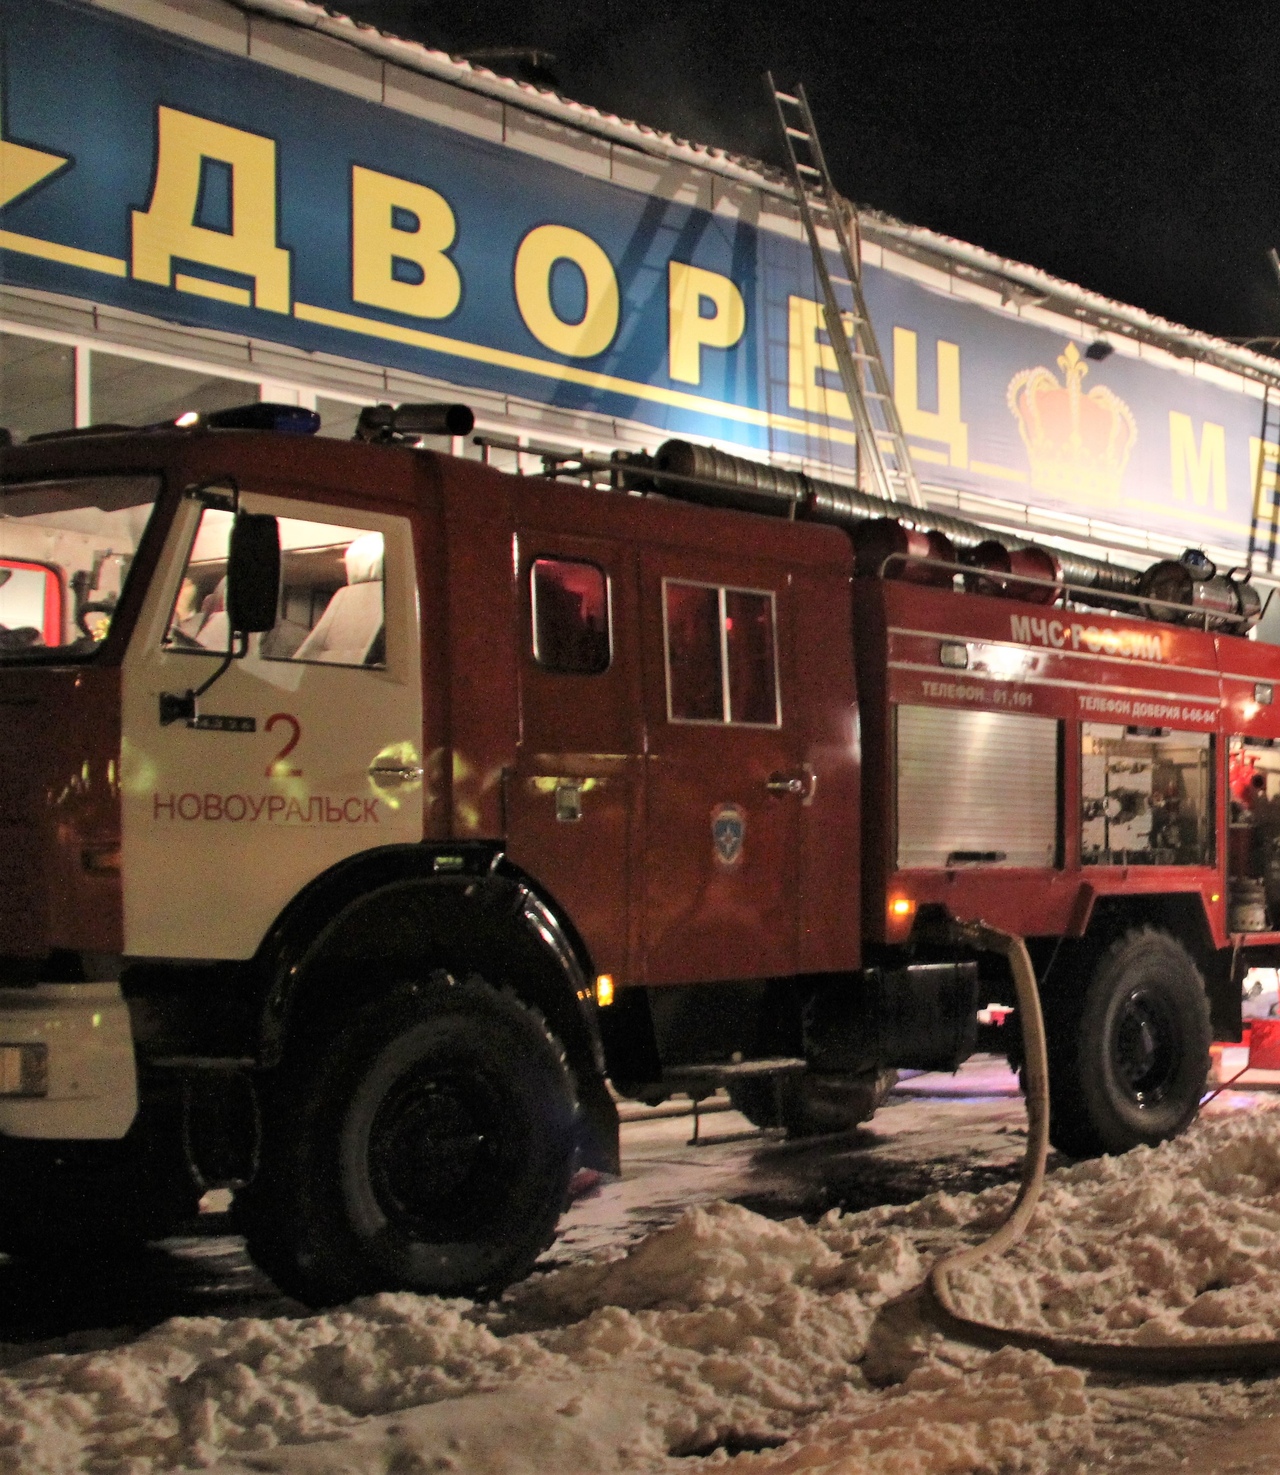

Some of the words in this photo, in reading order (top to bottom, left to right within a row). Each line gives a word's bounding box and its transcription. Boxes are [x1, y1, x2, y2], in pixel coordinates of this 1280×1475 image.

[131, 105, 968, 468] ДВОРЕЦ
[1010, 614, 1065, 647] МЧС
[1070, 623, 1163, 661] РОССИИ
[922, 681, 984, 702] ТЕЛЕФОН
[1079, 696, 1130, 714] ТЕЛЕФОН
[1132, 702, 1180, 719] ДОВЕРИЯ
[264, 713, 303, 777] 2
[153, 792, 380, 824] НОВОУРАЛЬСК
